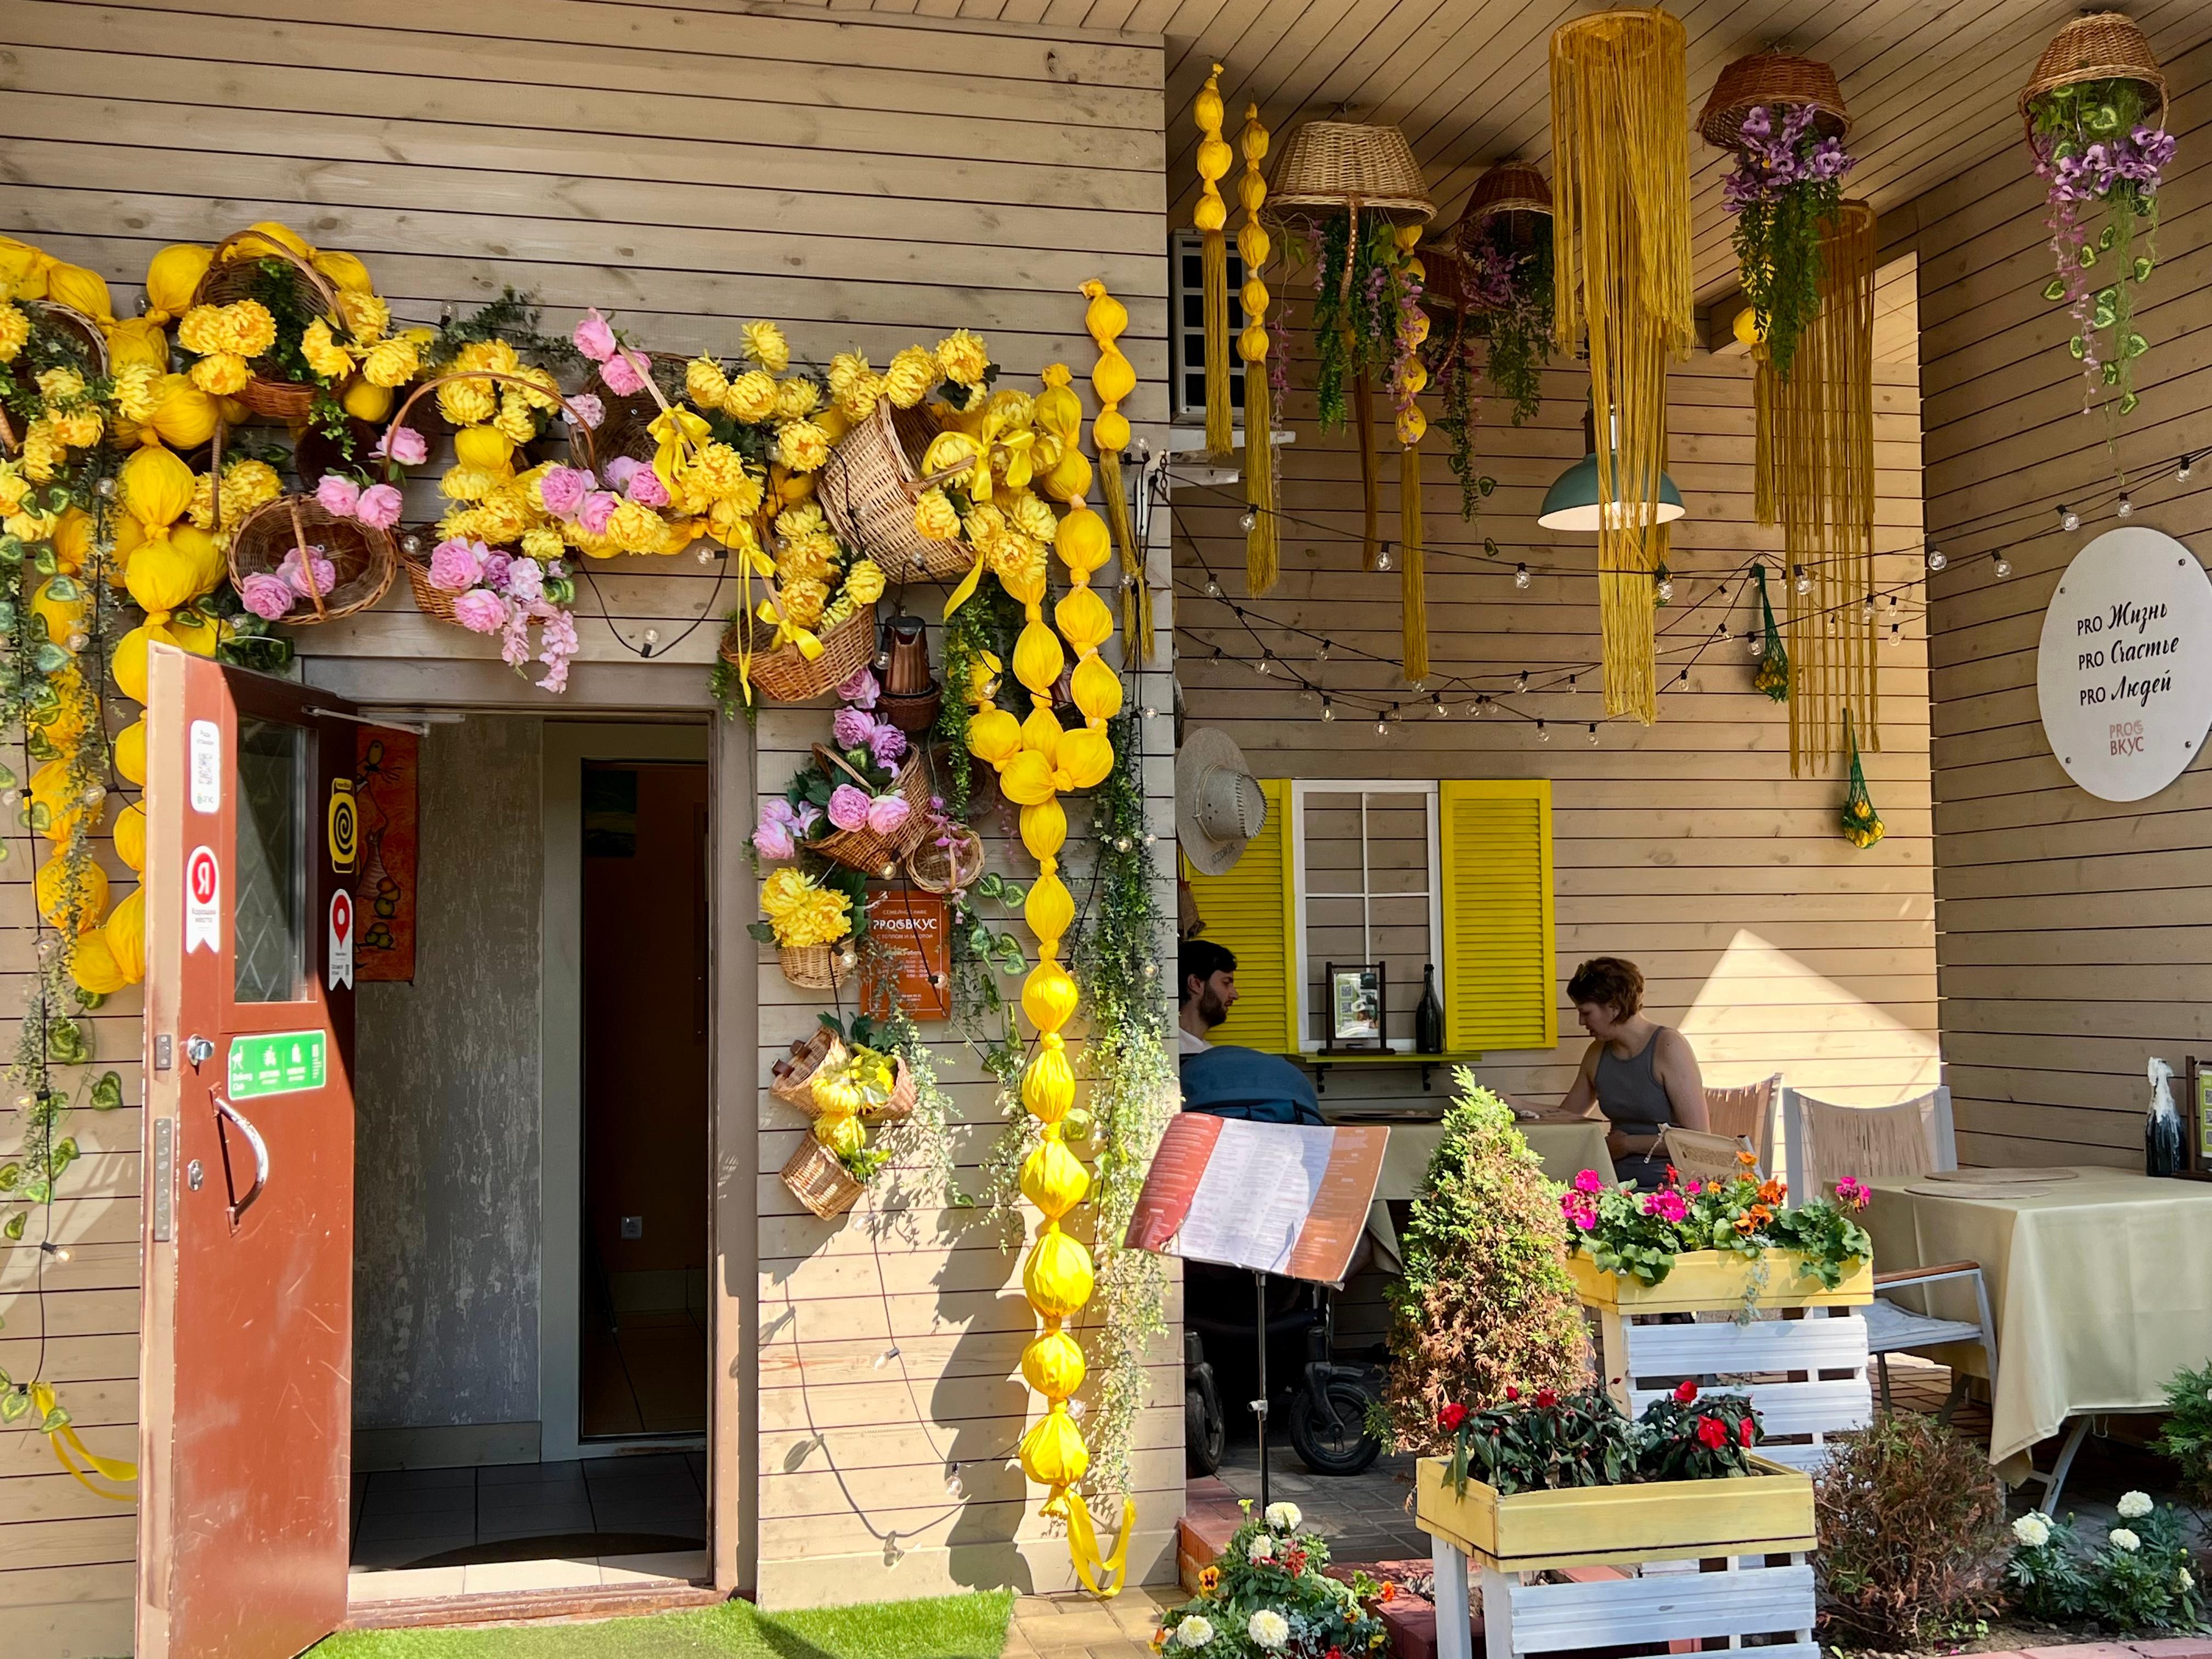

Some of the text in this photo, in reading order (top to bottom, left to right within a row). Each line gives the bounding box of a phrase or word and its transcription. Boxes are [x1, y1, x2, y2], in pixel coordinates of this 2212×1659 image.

[2076, 601, 2168, 636] PRO Жизнь
[2078, 637, 2179, 670] PRO Счастье
[2080, 670, 2171, 707] PRO Людей
[2110, 736, 2144, 757] ВКУС
